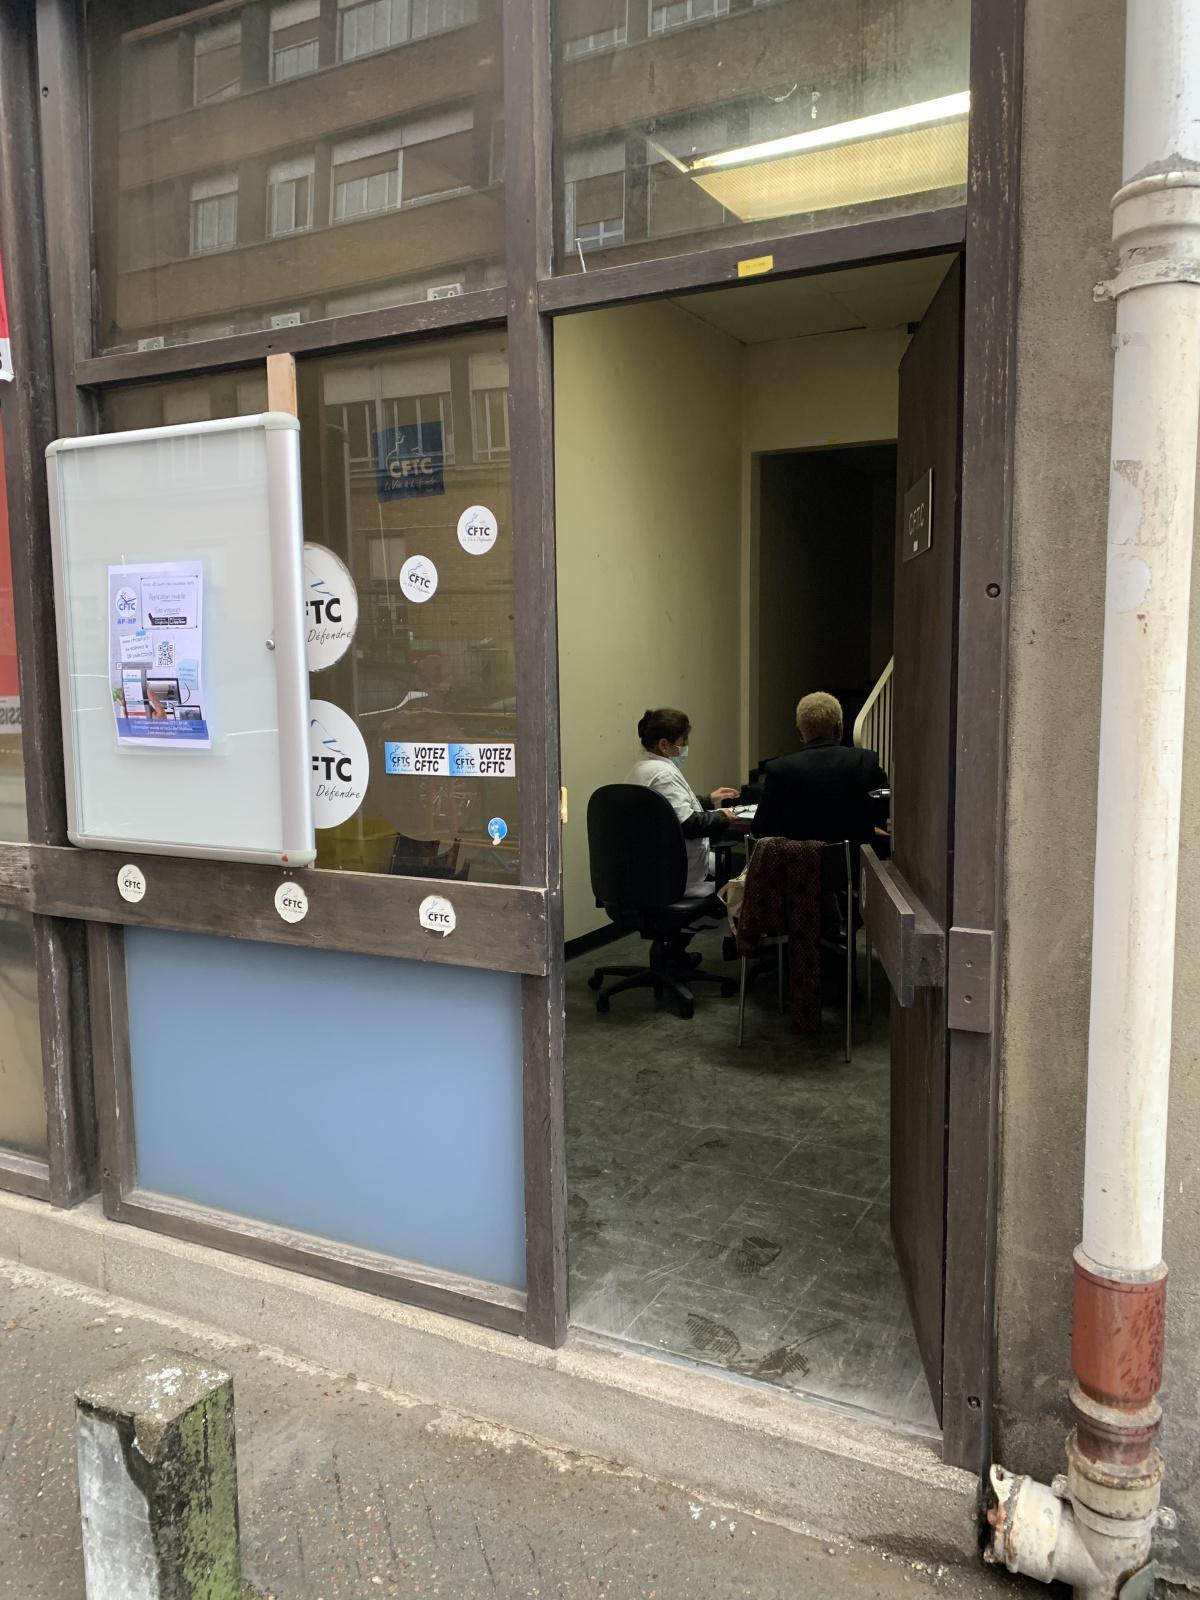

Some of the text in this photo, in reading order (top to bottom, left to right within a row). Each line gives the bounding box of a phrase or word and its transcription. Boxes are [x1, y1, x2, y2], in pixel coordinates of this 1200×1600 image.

[389, 457, 433, 478] CFTC
[467, 527, 490, 537] CFTC
[409, 573, 431, 588] CFTC
[307, 627, 352, 645] Défendre
[414, 747, 445, 760] VOTEZ
[479, 748, 512, 760] VOTEZ
[392, 756, 410, 765] CFTC
[414, 760, 439, 772] CFTC
[455, 758, 475, 766] CFTC
[479, 761, 505, 773] CFTC
[316, 784, 361, 801] Défendre
[124, 880, 141, 890] CFTC
[282, 898, 302, 909] CFTC
[428, 913, 450, 923] CFTC
